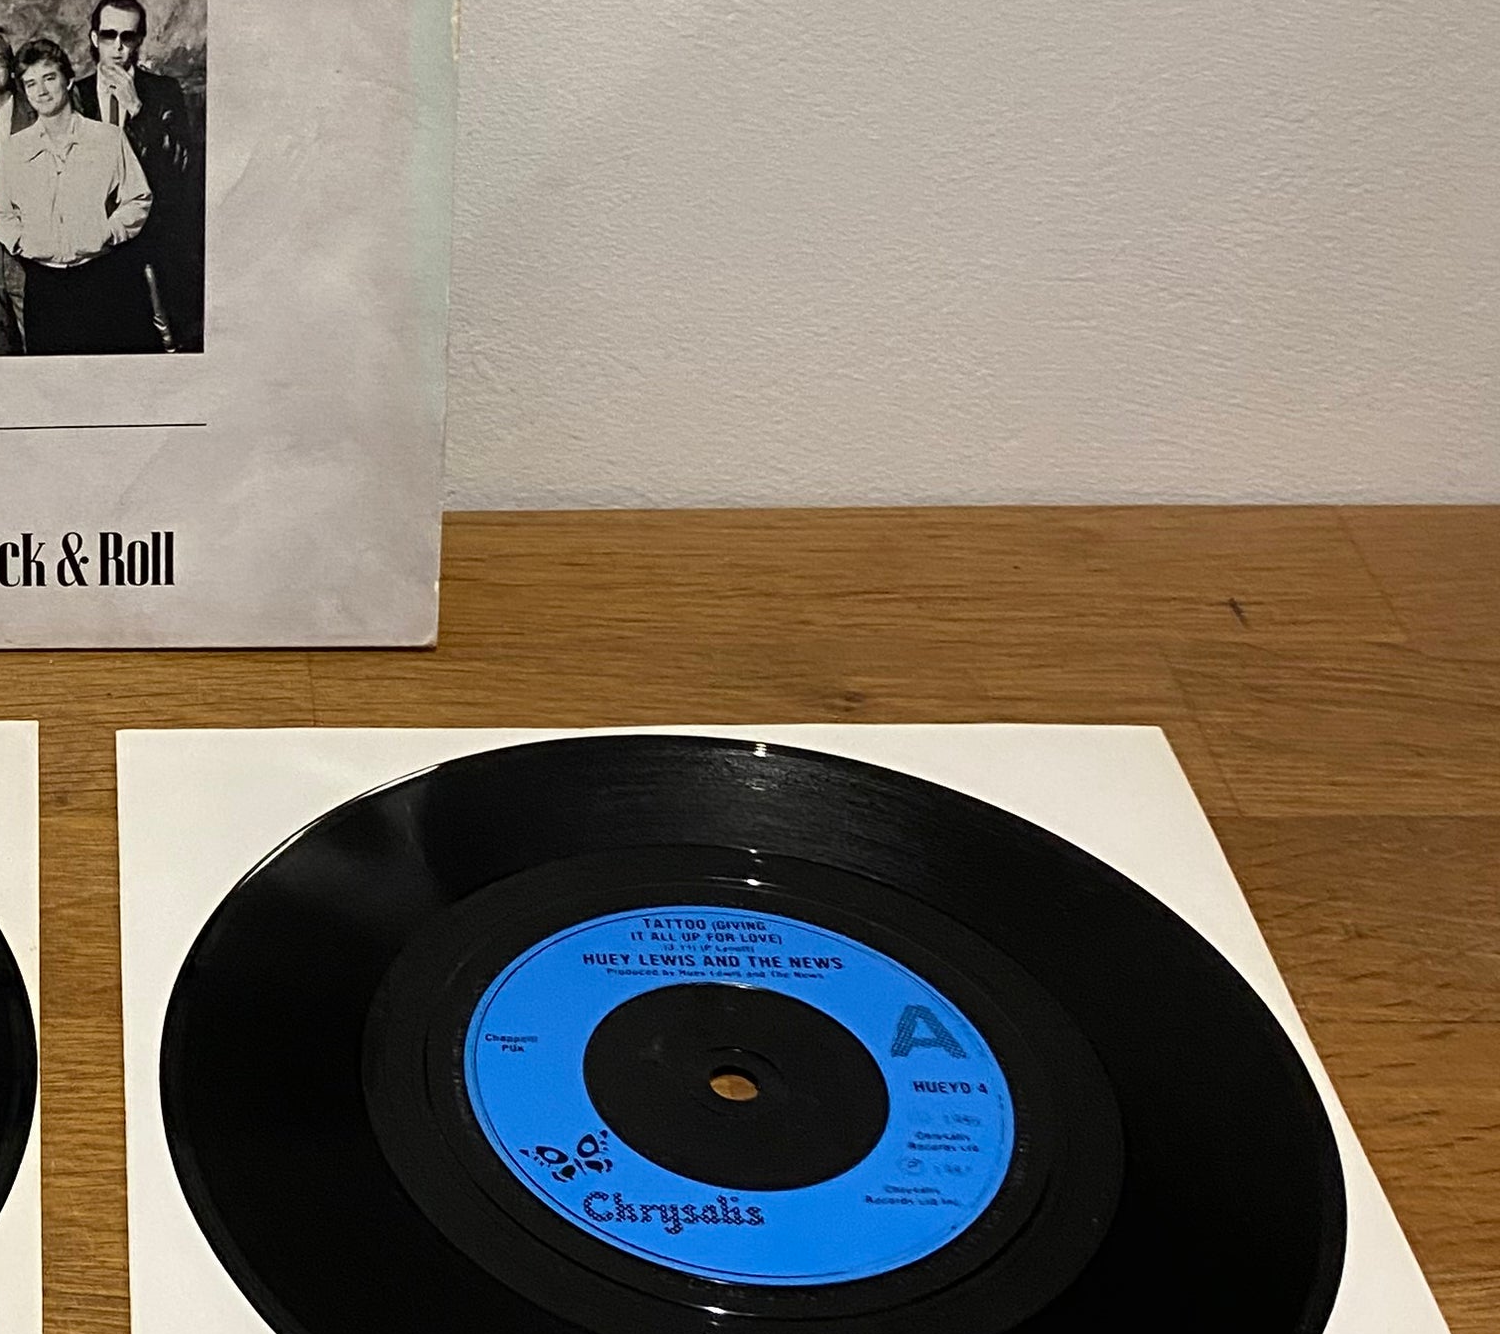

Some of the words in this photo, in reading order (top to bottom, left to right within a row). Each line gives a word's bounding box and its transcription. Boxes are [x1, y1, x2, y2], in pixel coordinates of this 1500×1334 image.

[56, 531, 90, 587] &
[98, 531, 175, 586] Roll
[642, 918, 707, 930] TATTOO
[711, 920, 768, 932] (GIVING
[631, 932, 645, 942] IT
[650, 932, 676, 943] ALL
[681, 933, 702, 943] UP
[706, 933, 736, 944] FOR
[739, 934, 783, 946] LOVE)
[582, 953, 632, 966] HUEY
[638, 954, 696, 968] LEWIS
[703, 955, 741, 968] AND
[749, 956, 783, 969] THE
[788, 957, 844, 970] NEWS
[890, 1004, 967, 1059] A
[912, 1081, 971, 1095] HUEYD
[978, 1083, 989, 1095] 4
[583, 1191, 765, 1235] Chrysalis
